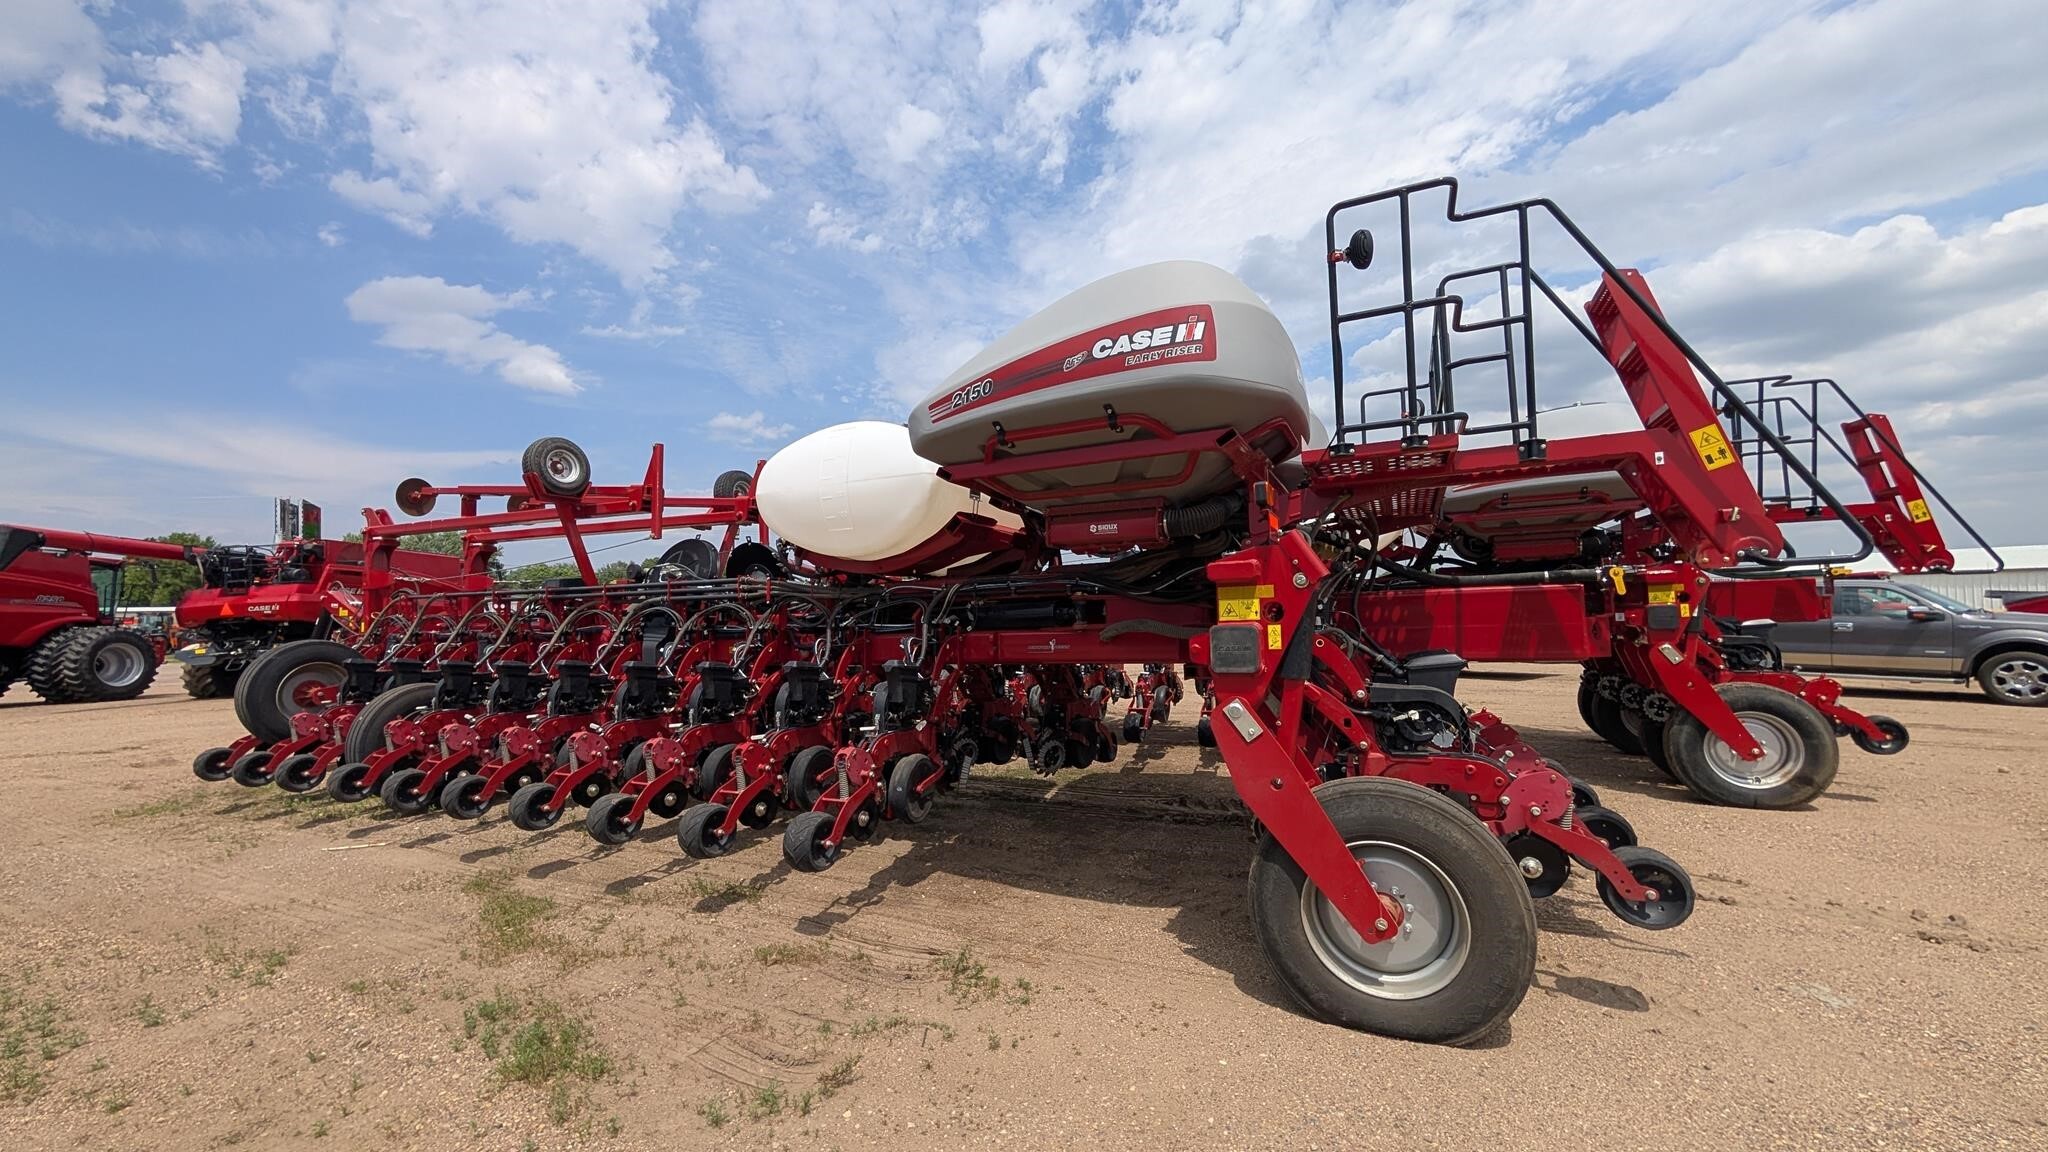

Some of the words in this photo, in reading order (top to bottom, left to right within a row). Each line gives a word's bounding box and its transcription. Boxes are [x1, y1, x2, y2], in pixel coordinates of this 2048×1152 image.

[1092, 325, 1174, 359] CASE
[1175, 315, 1206, 343] IH
[1125, 350, 1164, 366] EARLY
[1164, 344, 1203, 359] RISER
[952, 378, 993, 409] 2150
[1097, 523, 1118, 531] SIOUX
